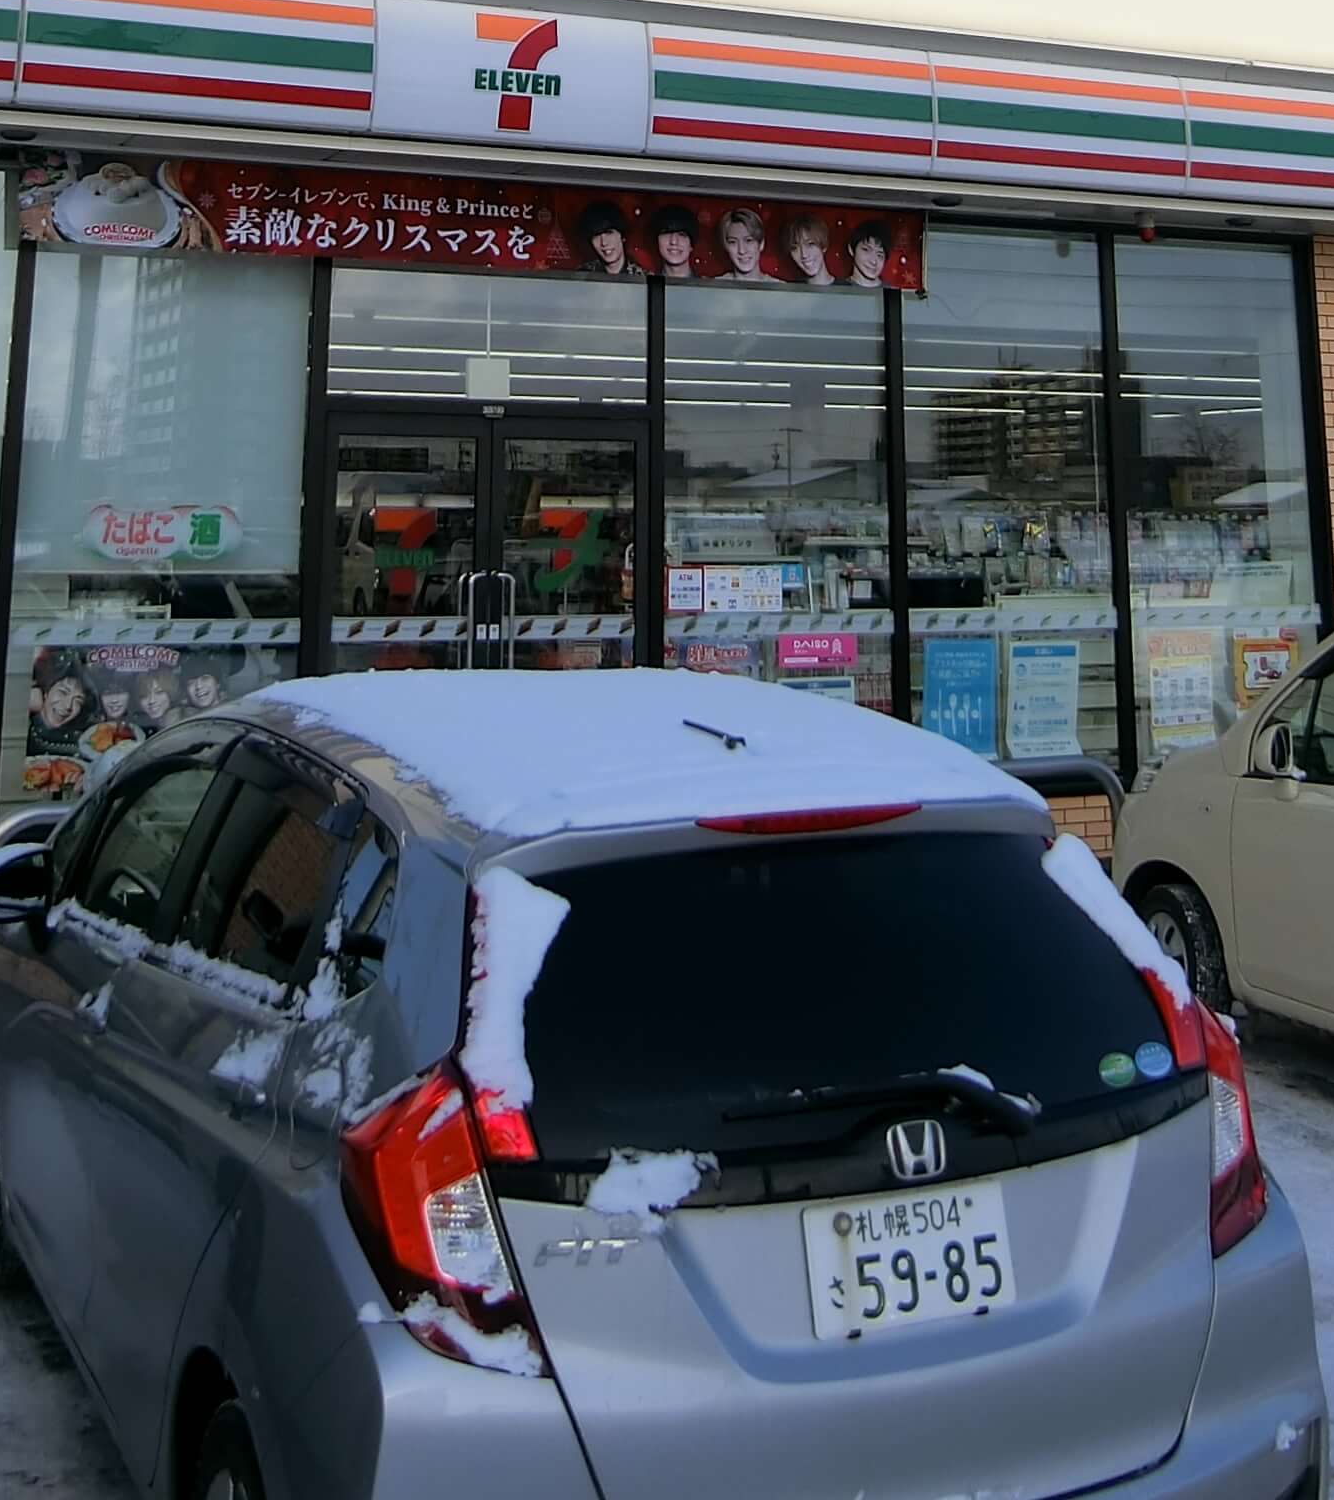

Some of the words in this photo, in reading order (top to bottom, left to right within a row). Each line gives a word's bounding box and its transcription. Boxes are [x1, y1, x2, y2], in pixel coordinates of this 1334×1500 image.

[382, 192, 432, 217] King
[436, 197, 451, 214] &
[455, 198, 534, 220] Princeと
[83, 224, 118, 236] COME
[121, 224, 155, 240] COME
[224, 205, 535, 260] 素敵なクリスマスを
[102, 511, 174, 545] たばこ
[189, 512, 222, 546] 酒
[854, 1204, 911, 1243] 札幌
[912, 1195, 961, 1234] 504
[828, 1275, 845, 1309] さ
[855, 1233, 1003, 1319] 59-85
